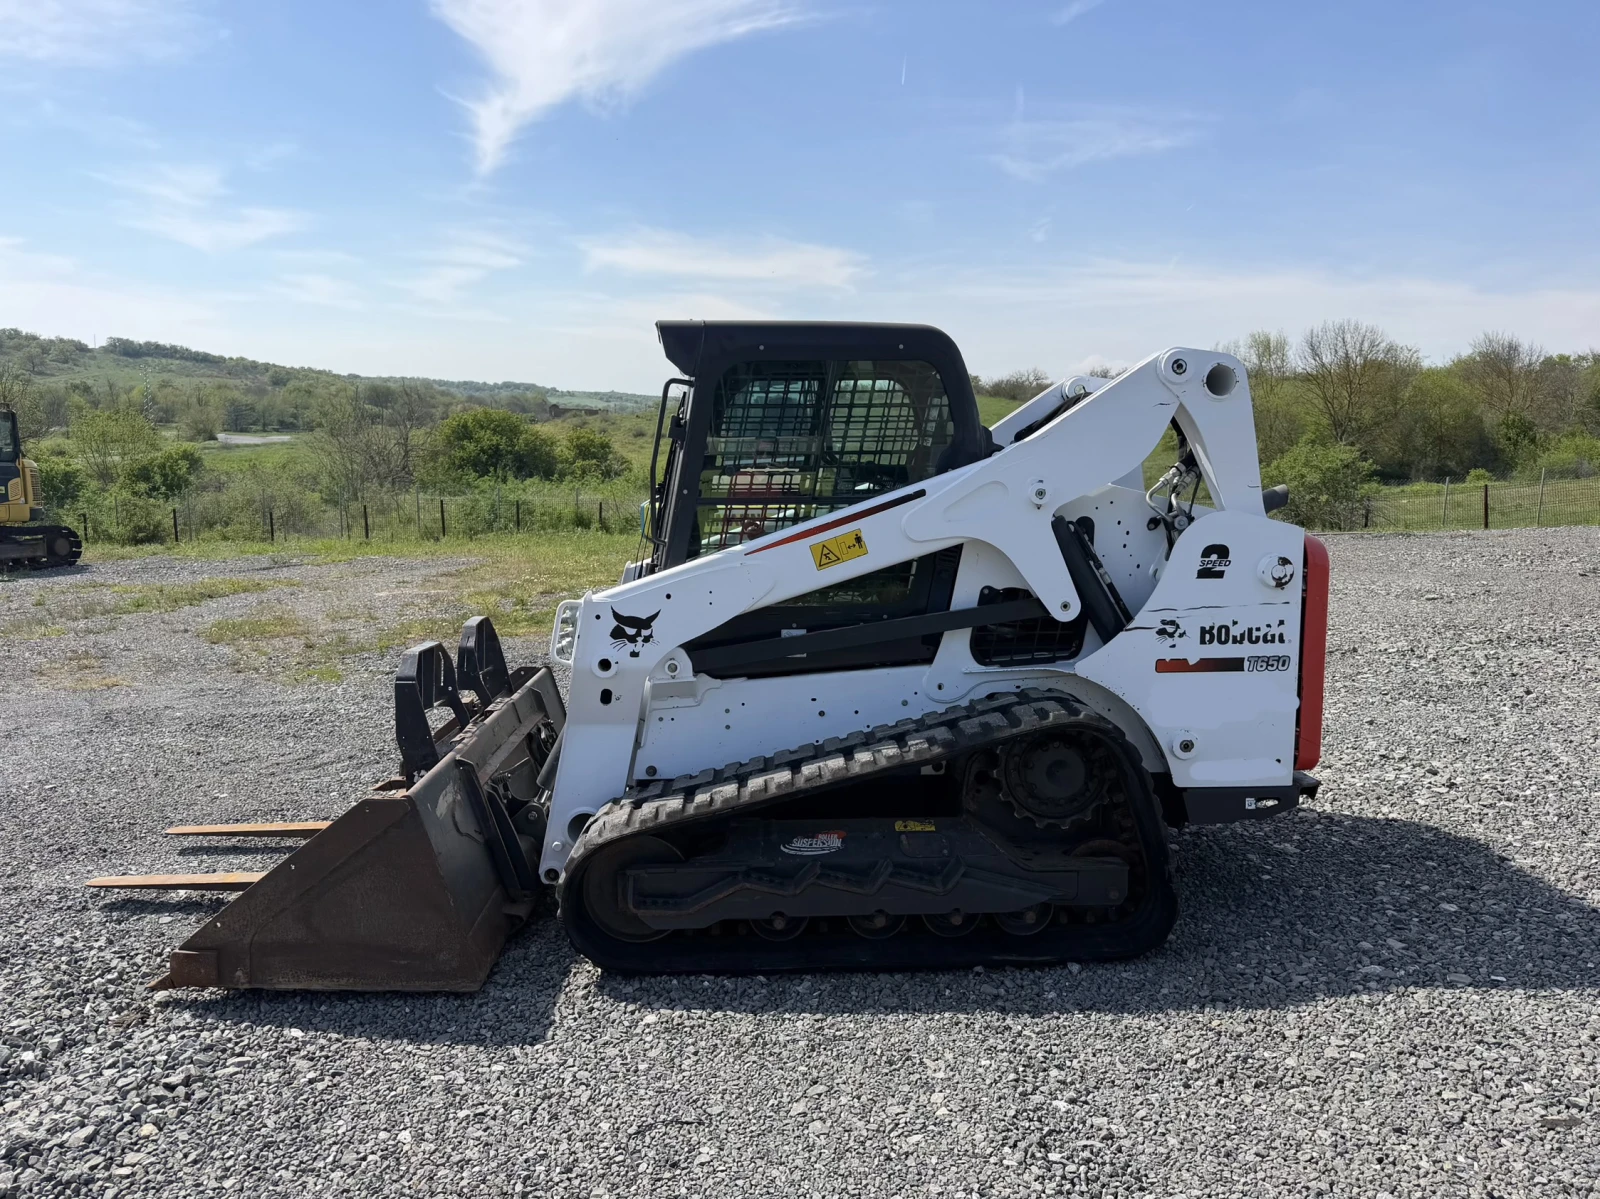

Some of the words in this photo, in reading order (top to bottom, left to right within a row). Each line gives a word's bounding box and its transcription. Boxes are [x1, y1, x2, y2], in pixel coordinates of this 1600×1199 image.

[1195, 543, 1230, 579] 2
[1199, 559, 1232, 567] SPEED
[1247, 655, 1291, 672] T650
